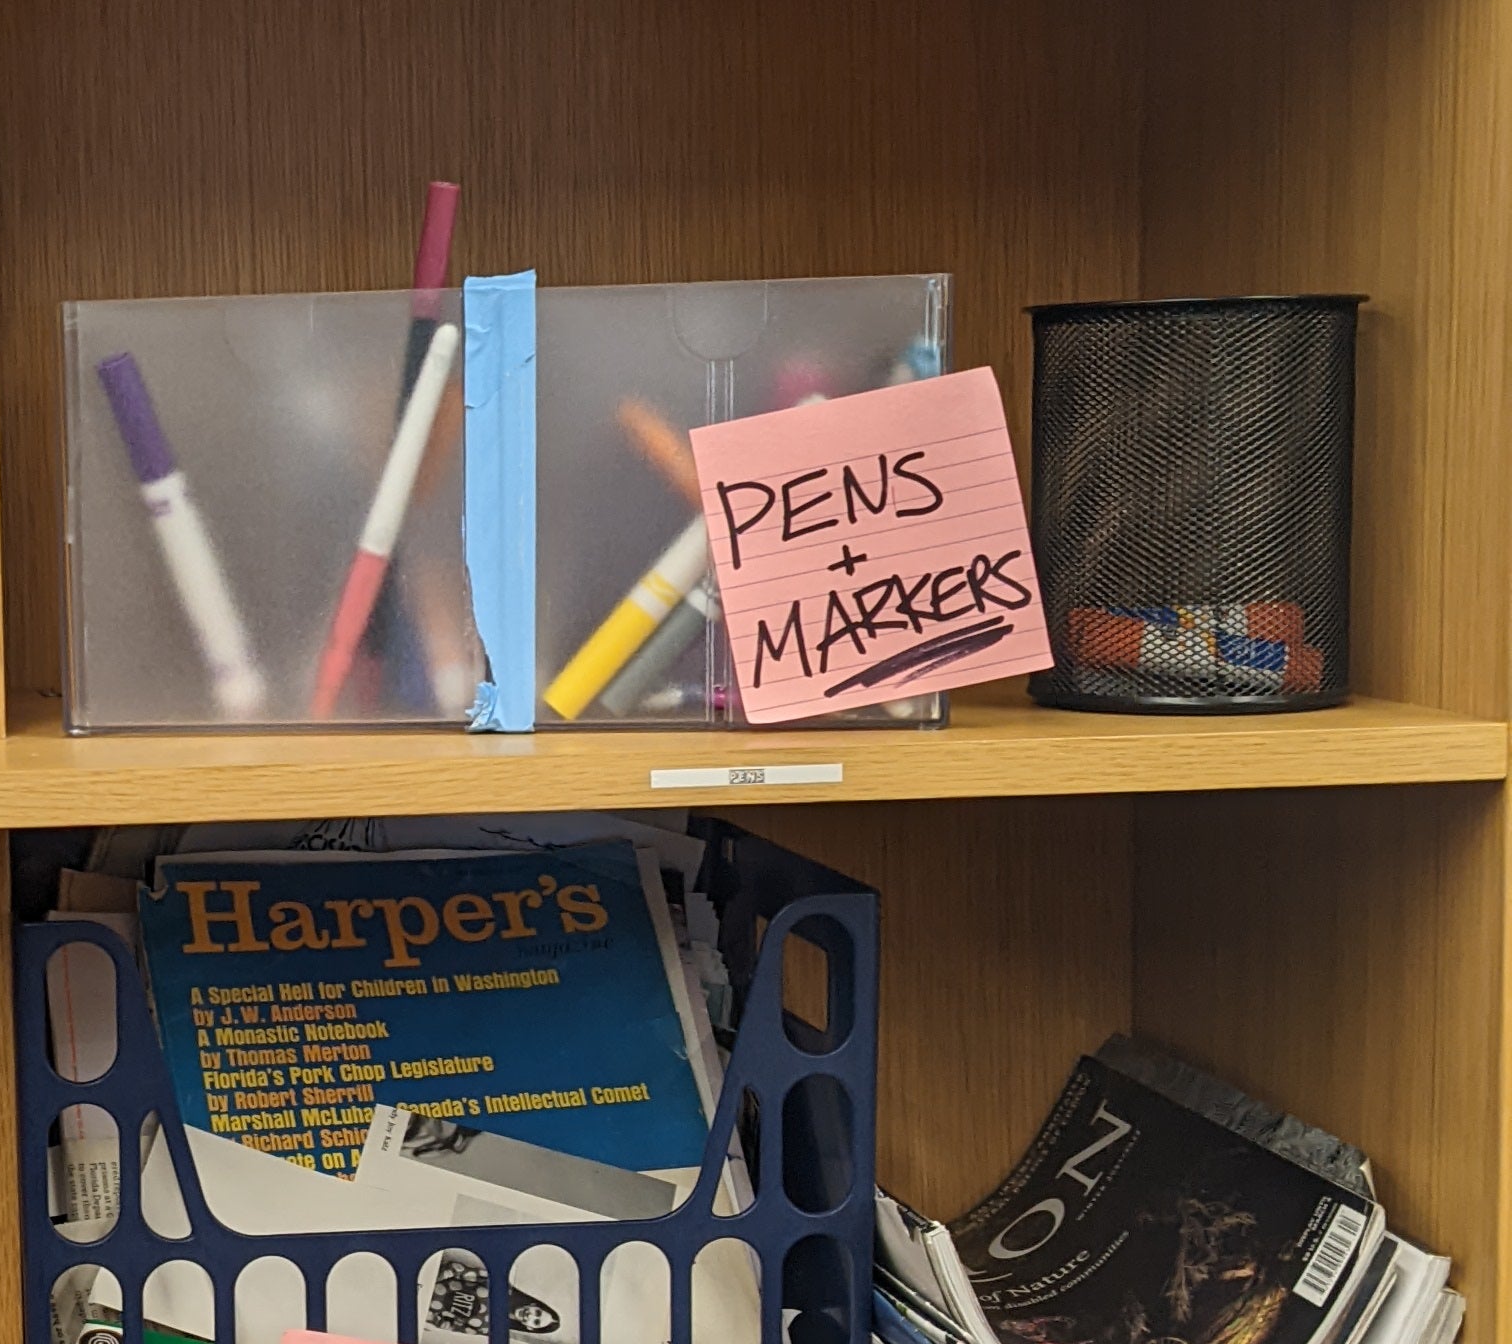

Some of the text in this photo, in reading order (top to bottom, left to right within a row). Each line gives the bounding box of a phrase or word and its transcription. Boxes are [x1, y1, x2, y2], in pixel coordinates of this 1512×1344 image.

[716, 451, 944, 570] PENS
[826, 544, 868, 576] +
[753, 549, 1032, 689] MARKERS
[728, 768, 766, 785] PENS
[176, 874, 610, 969] Harper's
[190, 968, 560, 1006] A Special Hell for Children in Washington
[193, 1008, 215, 1027] by
[271, 1003, 358, 1023] Anderson
[198, 1020, 390, 1048] A Monastic Notebook
[200, 1043, 372, 1069] by Thomas Merton
[203, 1055, 495, 1090] Florida's Pork Chop Legislature
[206, 1084, 375, 1112] by Robert Sherrill
[210, 1108, 297, 1133] Marshall
[301, 1105, 375, 1127] McLuha
[484, 1087, 587, 1114] Intellectual
[591, 1083, 651, 1105] Comet
[241, 1132, 315, 1153] Richard
[284, 1154, 316, 1171] ote
[322, 1151, 346, 1170] on
[979, 1249, 1090, 1304] of Nature
[450, 1291, 476, 1318] RITZ
